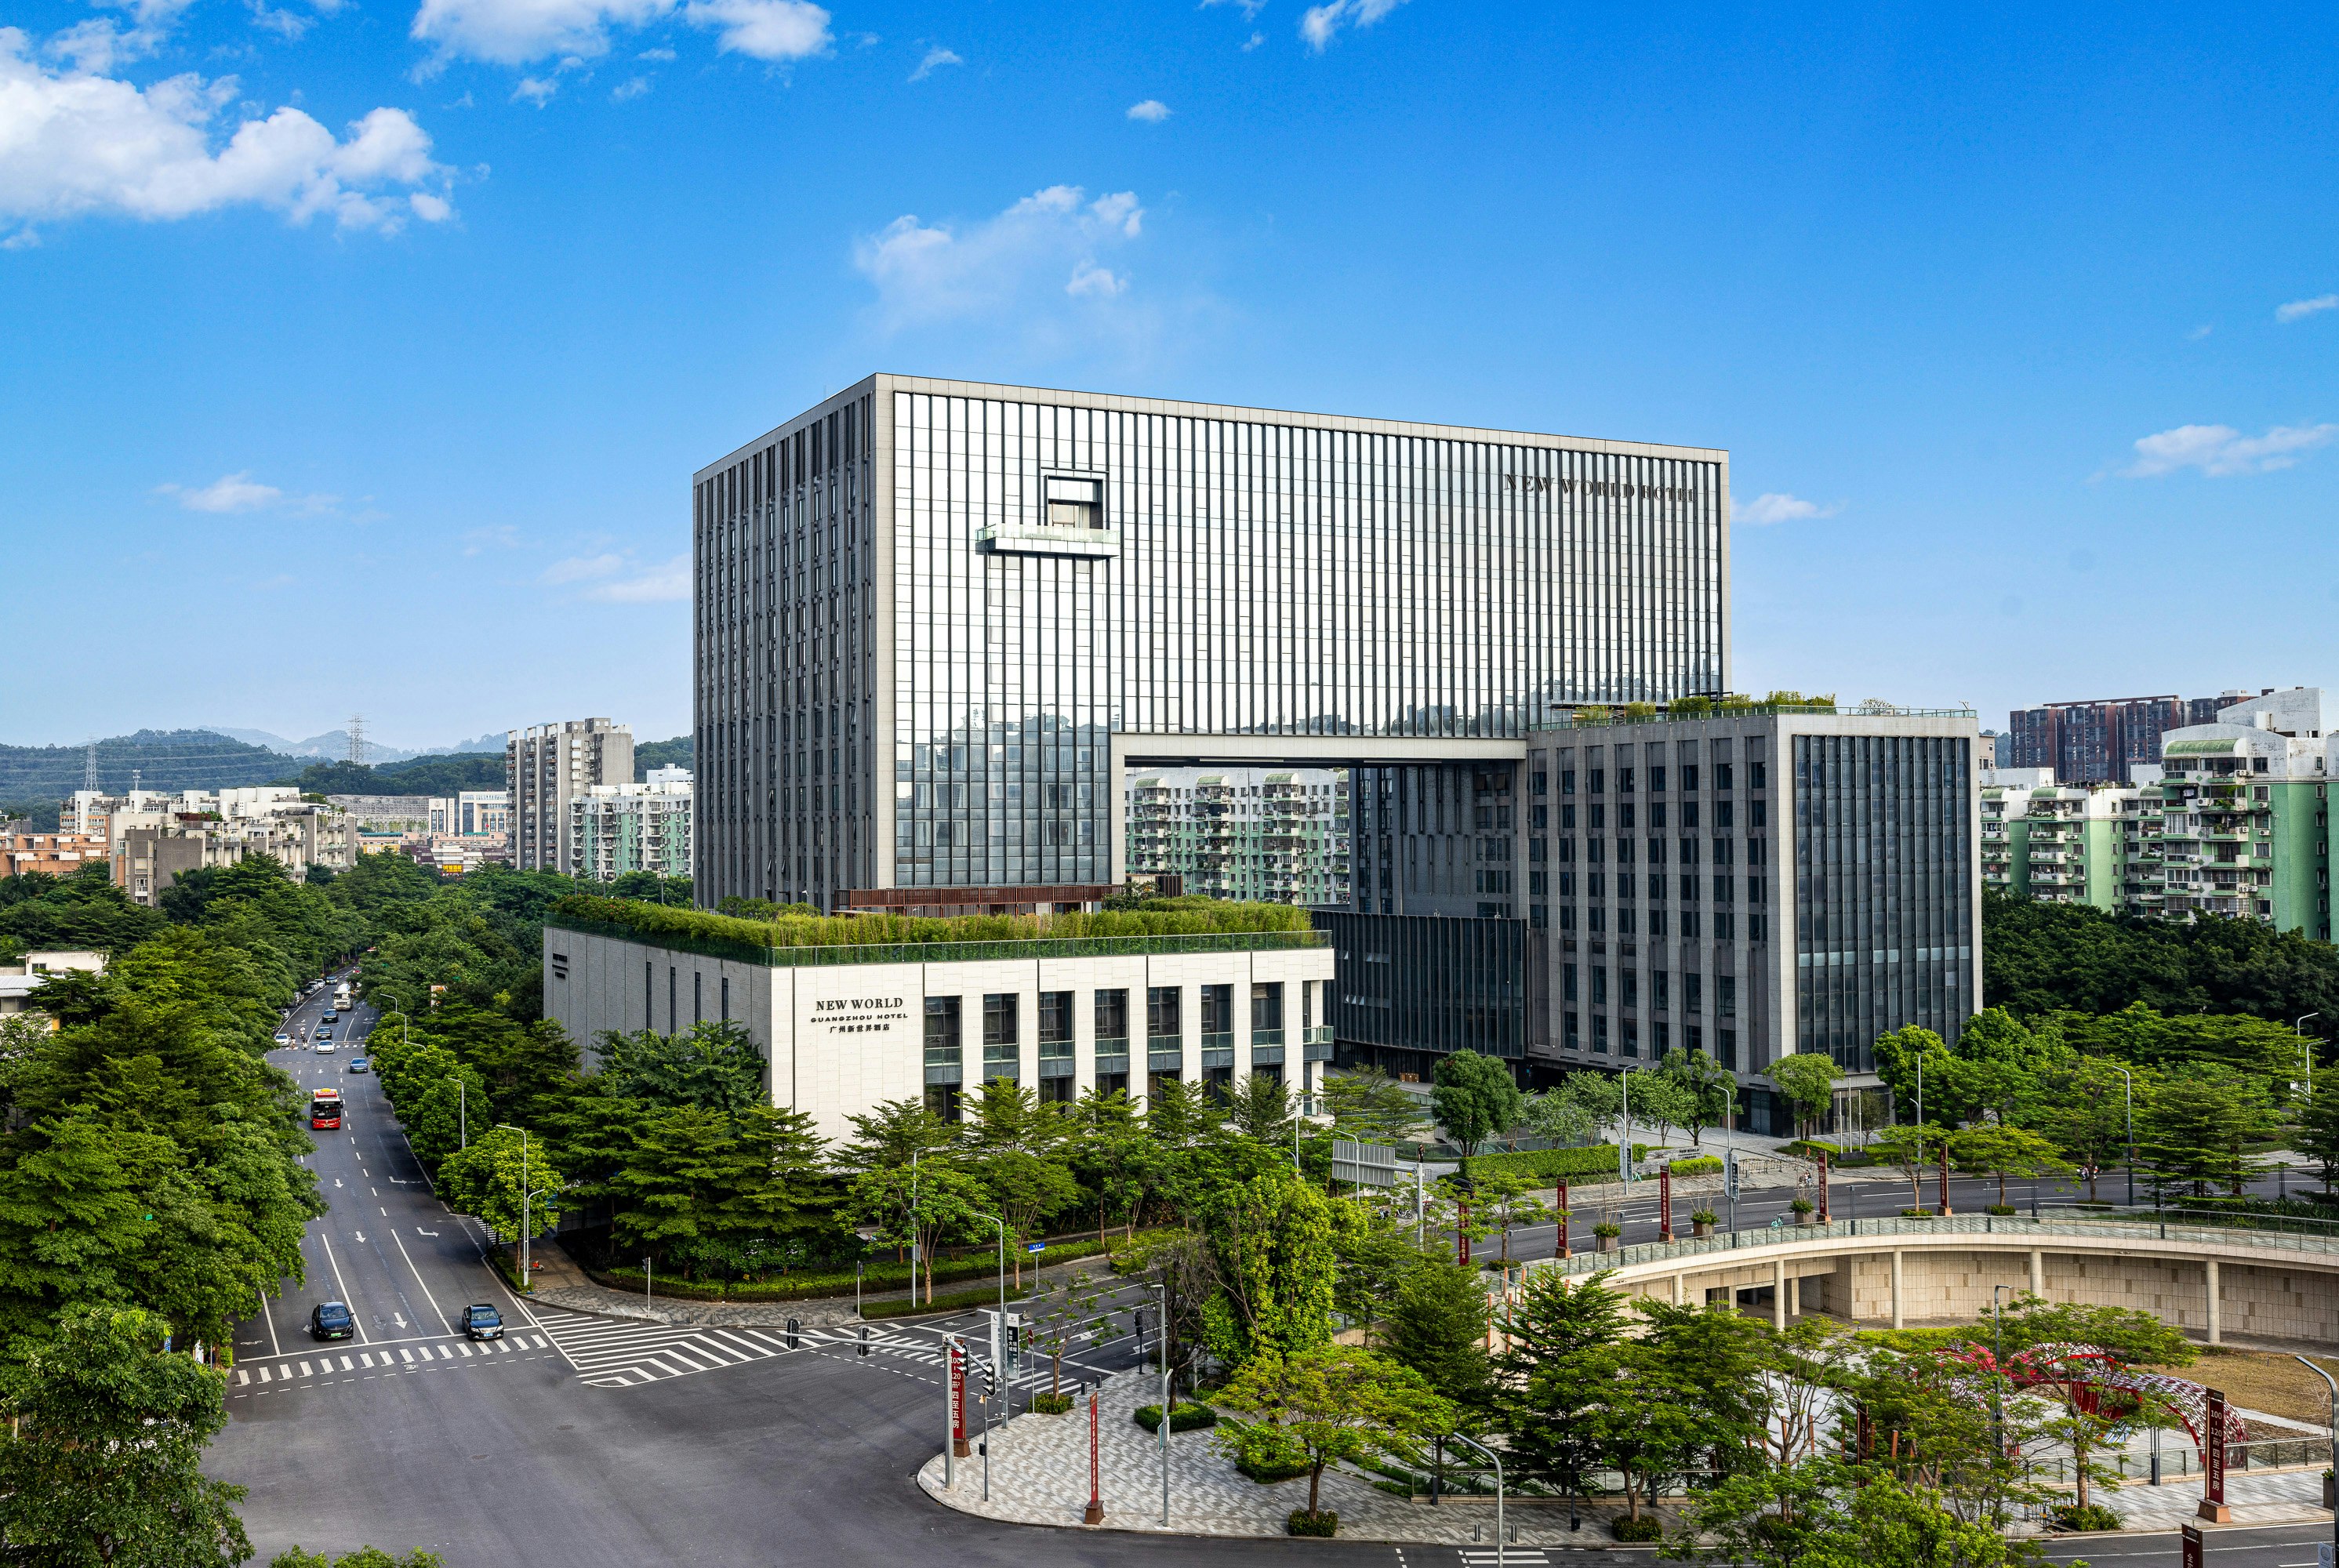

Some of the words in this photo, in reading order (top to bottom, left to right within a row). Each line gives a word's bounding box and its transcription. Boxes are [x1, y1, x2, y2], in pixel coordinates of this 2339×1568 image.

[1504, 474, 1554, 493] NEW
[1560, 478, 1635, 497] WORLD
[1641, 485, 1698, 503] HOTEL
[816, 1000, 848, 1011] NEW
[851, 997, 903, 1009] WORLD
[811, 1014, 873, 1023] GUANGZHOU
[830, 1023, 890, 1033] 广州新世界酒店
[2210, 1410, 2222, 1420] 100
[2210, 1427, 2223, 1437] 120
